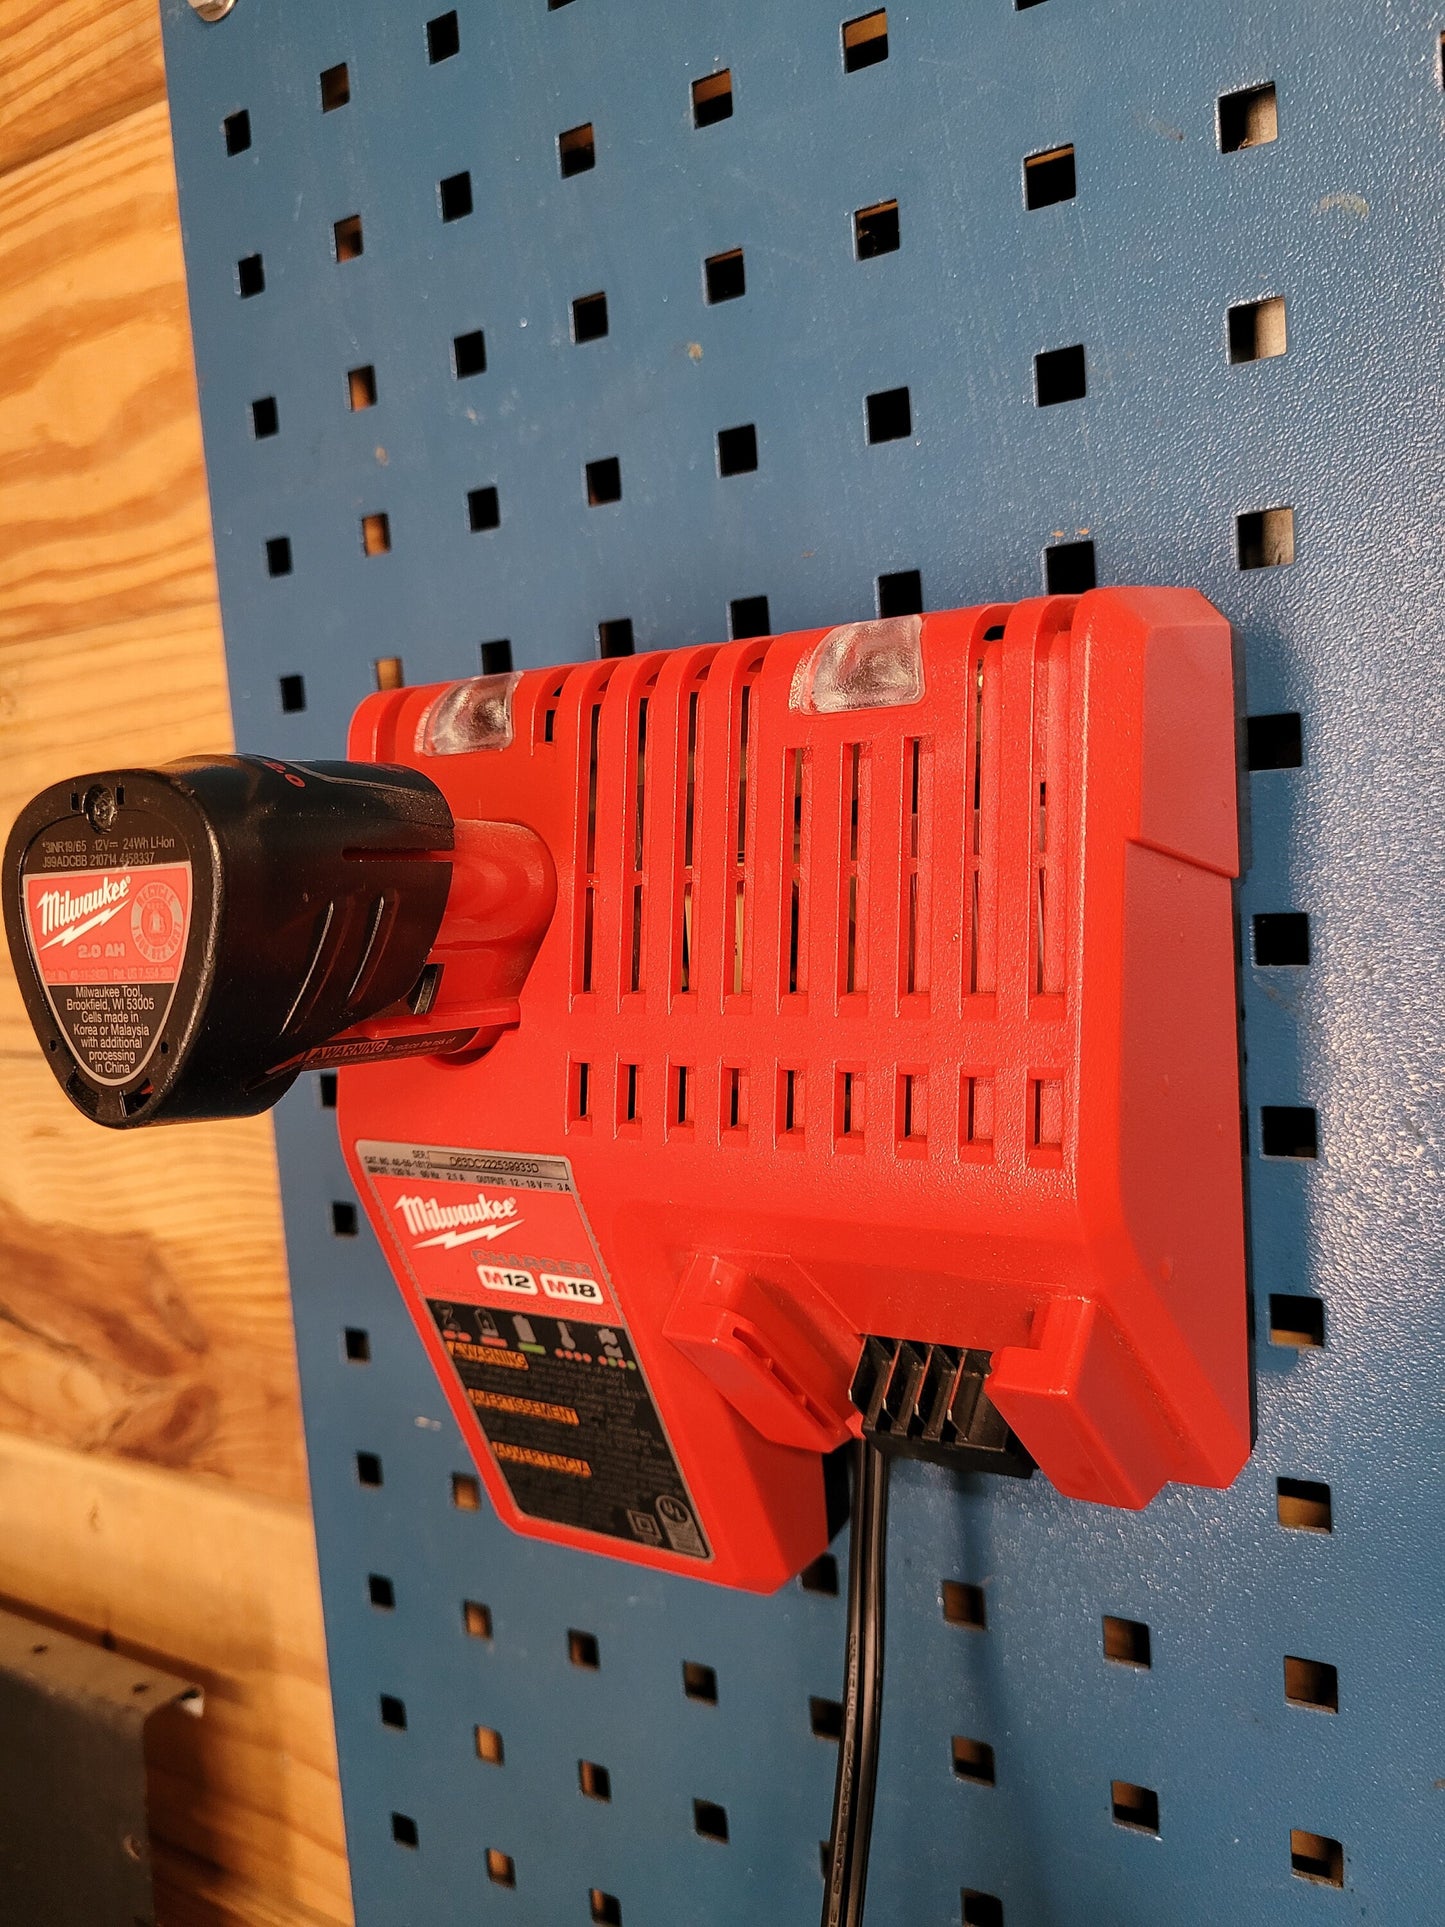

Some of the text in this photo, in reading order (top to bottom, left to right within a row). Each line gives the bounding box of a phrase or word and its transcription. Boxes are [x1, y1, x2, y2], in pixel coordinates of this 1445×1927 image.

[90, 853, 117, 867] 210714
[77, 943, 102, 958] 2.0
[75, 985, 143, 998] Milwaukee Tool,
[66, 998, 155, 1011] Brookfield, WI 53005
[81, 1011, 140, 1023] Cells made in
[73, 1024, 150, 1038] Korea or Malaysia
[81, 1036, 143, 1048] with additional
[326, 1041, 387, 1058] WARNING
[89, 1050, 136, 1064] processing
[95, 1061, 130, 1074] in China
[470, 1249, 594, 1278] CHARGER
[483, 1269, 597, 1299] M12 M18
[463, 1345, 528, 1367] WARNING
